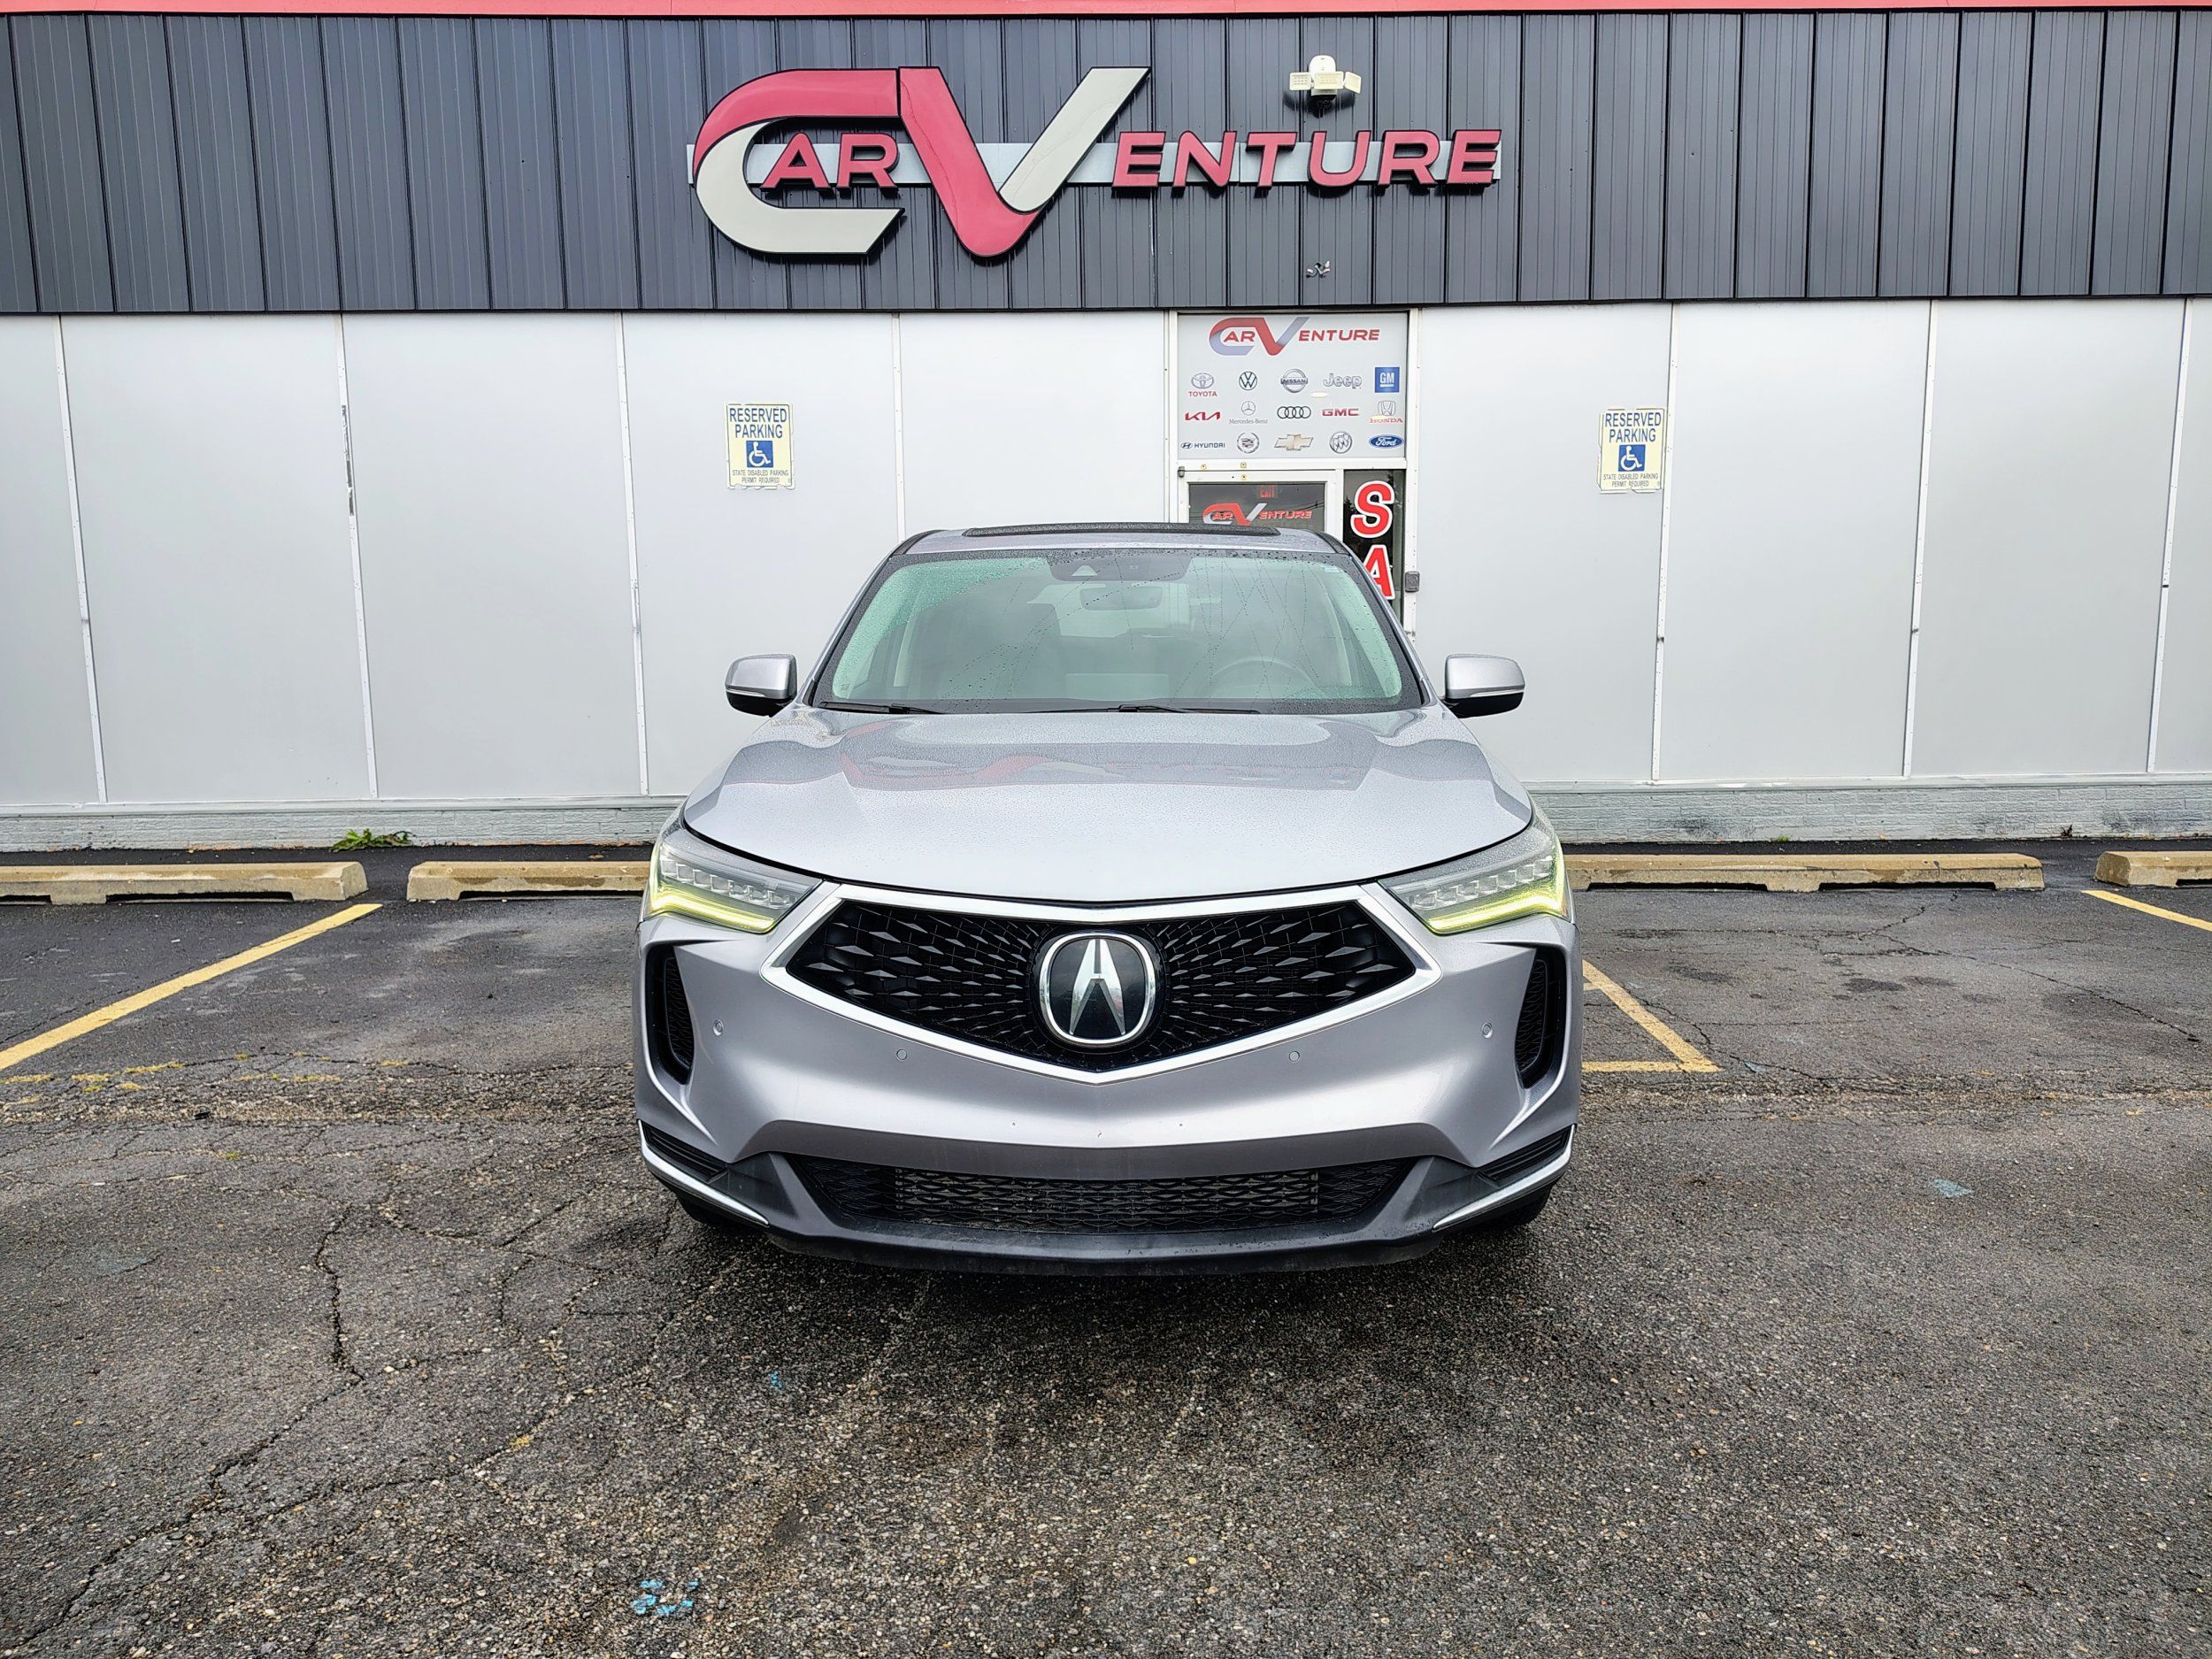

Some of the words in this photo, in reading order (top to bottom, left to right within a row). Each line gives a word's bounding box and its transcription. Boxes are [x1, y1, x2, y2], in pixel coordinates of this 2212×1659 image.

[1323, 373, 1363, 389] Jeep
[1379, 372, 1394, 384] GM
[729, 408, 787, 423] RESERVED
[1185, 411, 1221, 420] KIA
[1322, 408, 1359, 417] GMC
[1605, 412, 1662, 427] RESERVED
[735, 424, 783, 439] PARKING
[1609, 428, 1656, 443] PARKING
[1375, 436, 1398, 447] Ford
